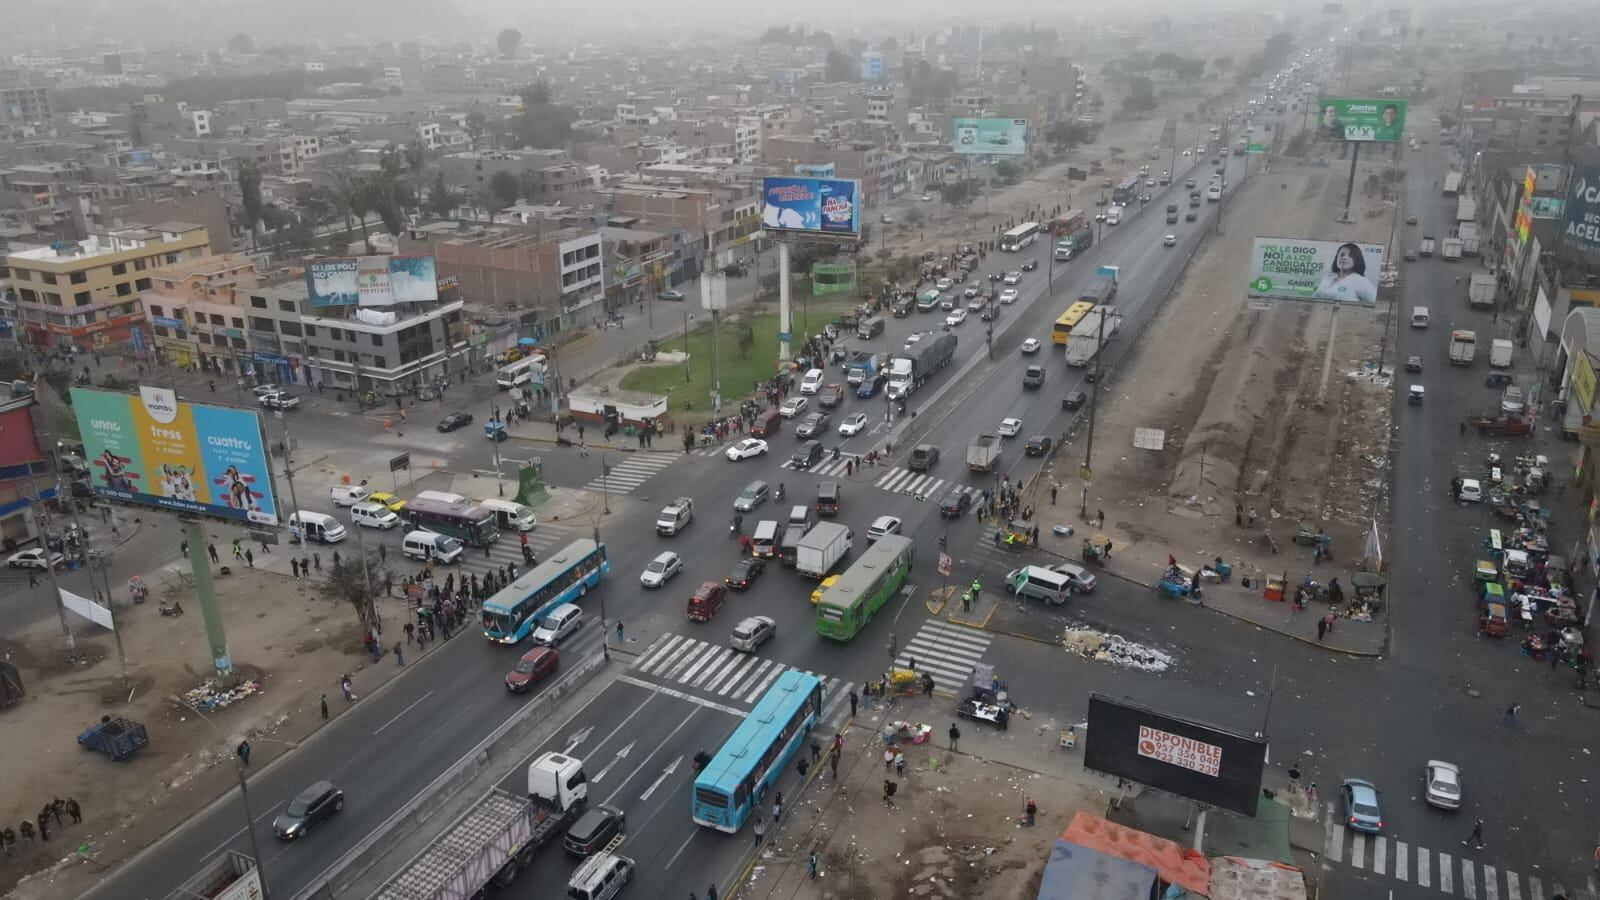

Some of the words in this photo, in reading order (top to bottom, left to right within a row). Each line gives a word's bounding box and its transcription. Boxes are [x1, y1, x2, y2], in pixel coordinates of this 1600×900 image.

[1292, 246, 1317, 255] DIGO
[1294, 254, 1313, 262] LOS
[1263, 259, 1325, 270] CANDIDATOS
[1140, 727, 1220, 759] DISPONIBLE
[1155, 751, 1174, 761] 923
[1177, 757, 1196, 768] 330
[1199, 764, 1218, 775] 239
[1156, 742, 1175, 753] 957
[1177, 748, 1196, 760] 356
[1200, 755, 1219, 767] 040
